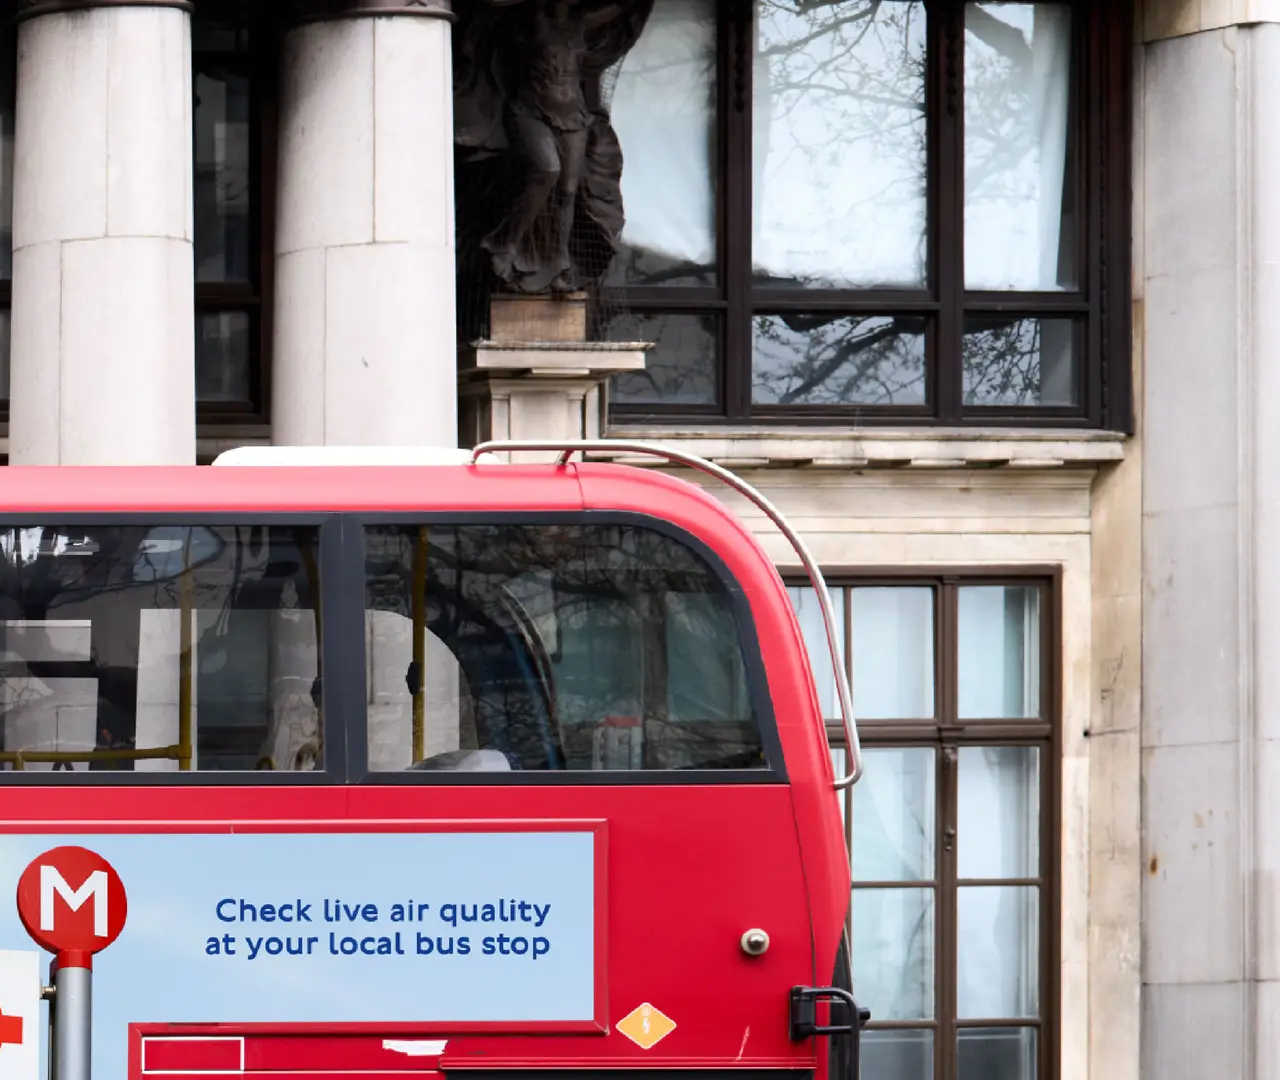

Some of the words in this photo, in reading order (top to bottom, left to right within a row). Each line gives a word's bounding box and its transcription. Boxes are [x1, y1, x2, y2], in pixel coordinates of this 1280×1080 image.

[40, 865, 109, 938] M
[215, 898, 313, 923] Check
[323, 898, 379, 923] live
[390, 899, 430, 923] air
[439, 898, 551, 928] quality
[205, 933, 236, 956] at
[245, 936, 319, 961] your
[329, 931, 405, 956] local
[416, 931, 471, 956] bus
[481, 933, 550, 961] stop
